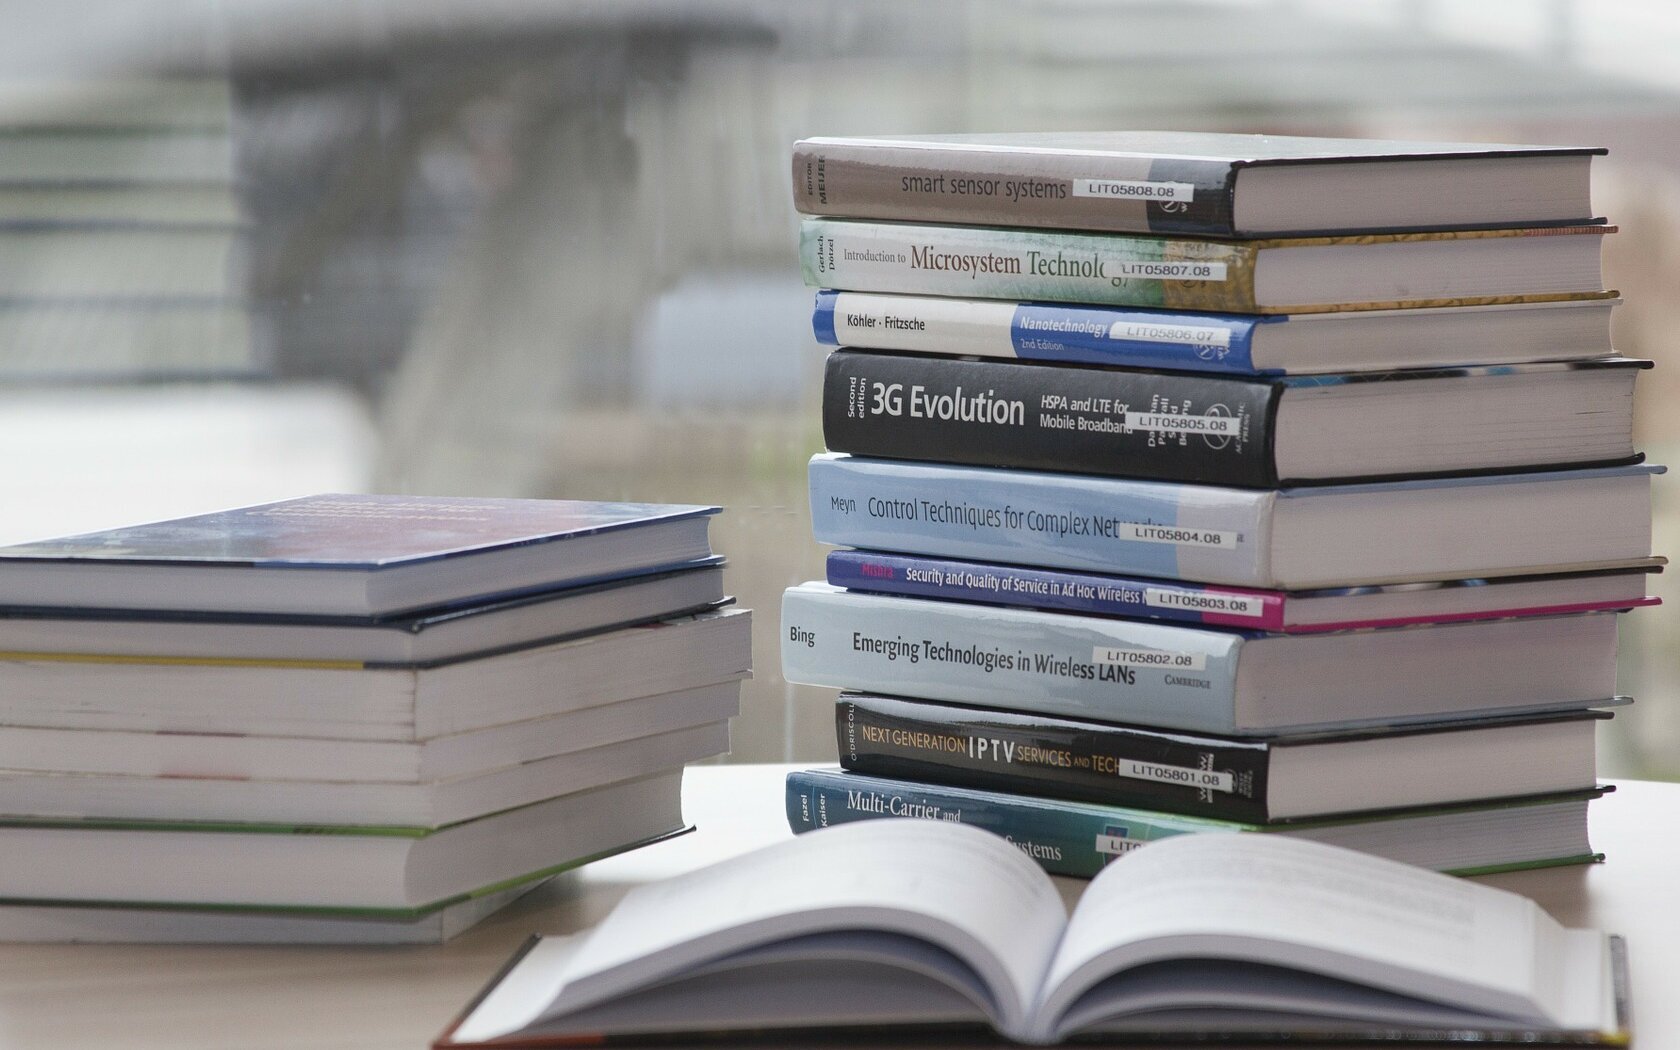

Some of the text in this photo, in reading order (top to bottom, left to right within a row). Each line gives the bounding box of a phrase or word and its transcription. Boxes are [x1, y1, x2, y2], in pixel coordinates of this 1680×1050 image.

[818, 155, 827, 204] MEIJER
[902, 174, 1066, 202] smart sensor systems
[1089, 184, 1175, 198] LIT05808.08
[818, 235, 826, 273] Gerlach
[844, 248, 895, 263] Introduction
[897, 254, 906, 263] to
[911, 245, 1021, 280] Microsystem
[1122, 264, 1211, 277] LIT05807.08
[847, 313, 925, 331] Köhler Fritzsche
[1020, 316, 1109, 338] Nanotechnology
[1127, 325, 1214, 341] LIT05806.07
[1020, 338, 1064, 351] 2nd Edition
[847, 376, 857, 418] Second
[859, 377, 867, 419] edition
[871, 382, 1024, 425] 3G Evolution
[1041, 395, 1130, 415] HSPA and LTE for
[1040, 413, 1075, 430] Mobile
[1139, 417, 1228, 431] LIT05805.08
[830, 496, 856, 515] Meyn
[868, 496, 918, 521] Control
[921, 500, 1001, 531] Techniques
[1004, 505, 1024, 530] for
[1027, 509, 1090, 539] Complex
[1135, 527, 1222, 544] LIT05804.08
[906, 567, 945, 587] Security
[945, 571, 964, 586] and
[965, 573, 1000, 592] Quality
[1001, 576, 1013, 591] of
[1013, 577, 1048, 595] Service
[1050, 579, 1060, 595] in
[1061, 581, 1075, 597] Ad
[1077, 583, 1095, 599] Hoc
[1097, 585, 1140, 604] Wireless
[1159, 593, 1248, 612] LIT05803.08
[790, 626, 815, 647] Bing
[853, 632, 1136, 686] Emerging Technologies in Wireless LANs
[1107, 650, 1193, 666] LIT05802.08
[848, 702, 857, 761] O'DRISCOLL
[862, 725, 890, 743] NEXT
[892, 730, 966, 754] GENERATION
[968, 736, 1015, 764] IPTV
[1017, 745, 1072, 768] SERVICES
[1073, 756, 1090, 768] AND
[1132, 763, 1220, 786] LIT05801.08
[801, 794, 809, 822] Fazel
[819, 793, 828, 827] Kaiser
[847, 790, 961, 823] Multi-Carrier and
